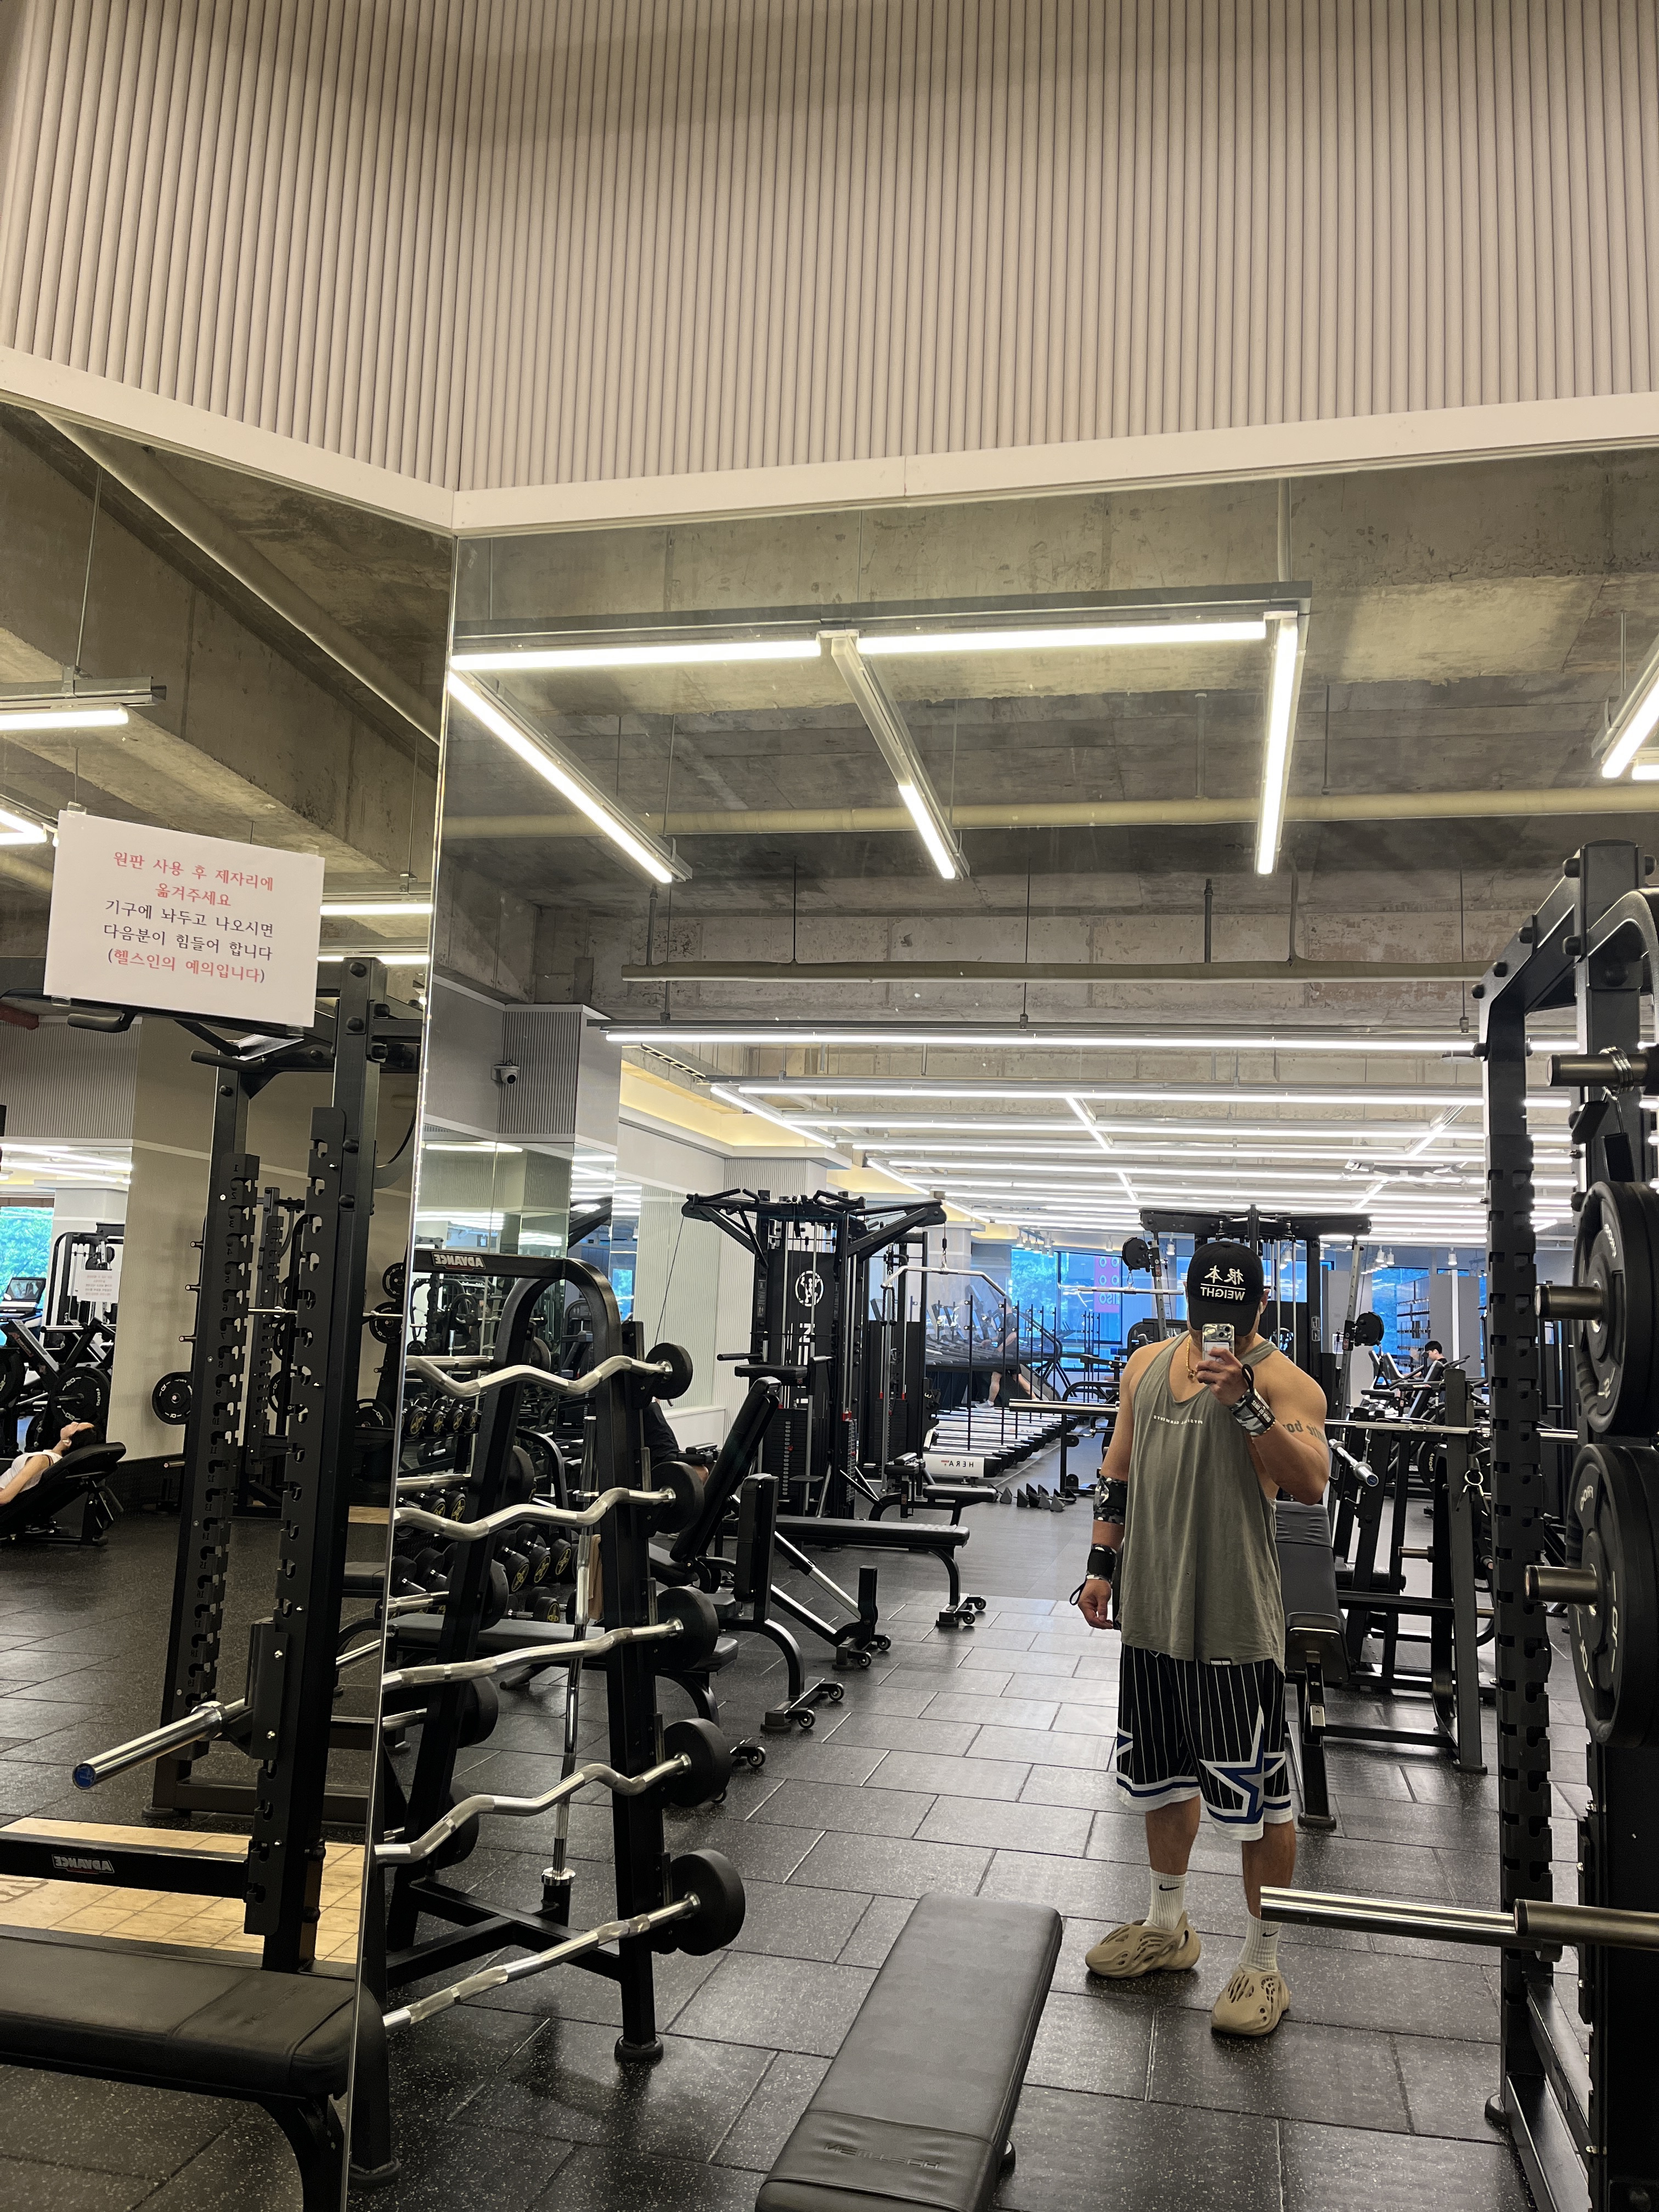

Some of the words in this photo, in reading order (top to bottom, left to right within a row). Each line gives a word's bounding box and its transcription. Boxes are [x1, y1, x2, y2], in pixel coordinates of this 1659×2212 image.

[114, 851, 145, 870] 원판
[153, 859, 184, 876] 사용
[192, 865, 207, 880] 후
[215, 869, 273, 891] 제자리에
[155, 883, 231, 906] 옮겨주세요
[105, 899, 152, 920] 기구에
[160, 908, 207, 926] 놔두고
[216, 916, 273, 938] 나오시면
[104, 923, 165, 946] 다음분이
[176, 934, 219, 953] 힘들어
[229, 941, 273, 961] 합니다
[108, 948, 175, 972] (헬스인의
[185, 960, 264, 984] 예의입니다)
